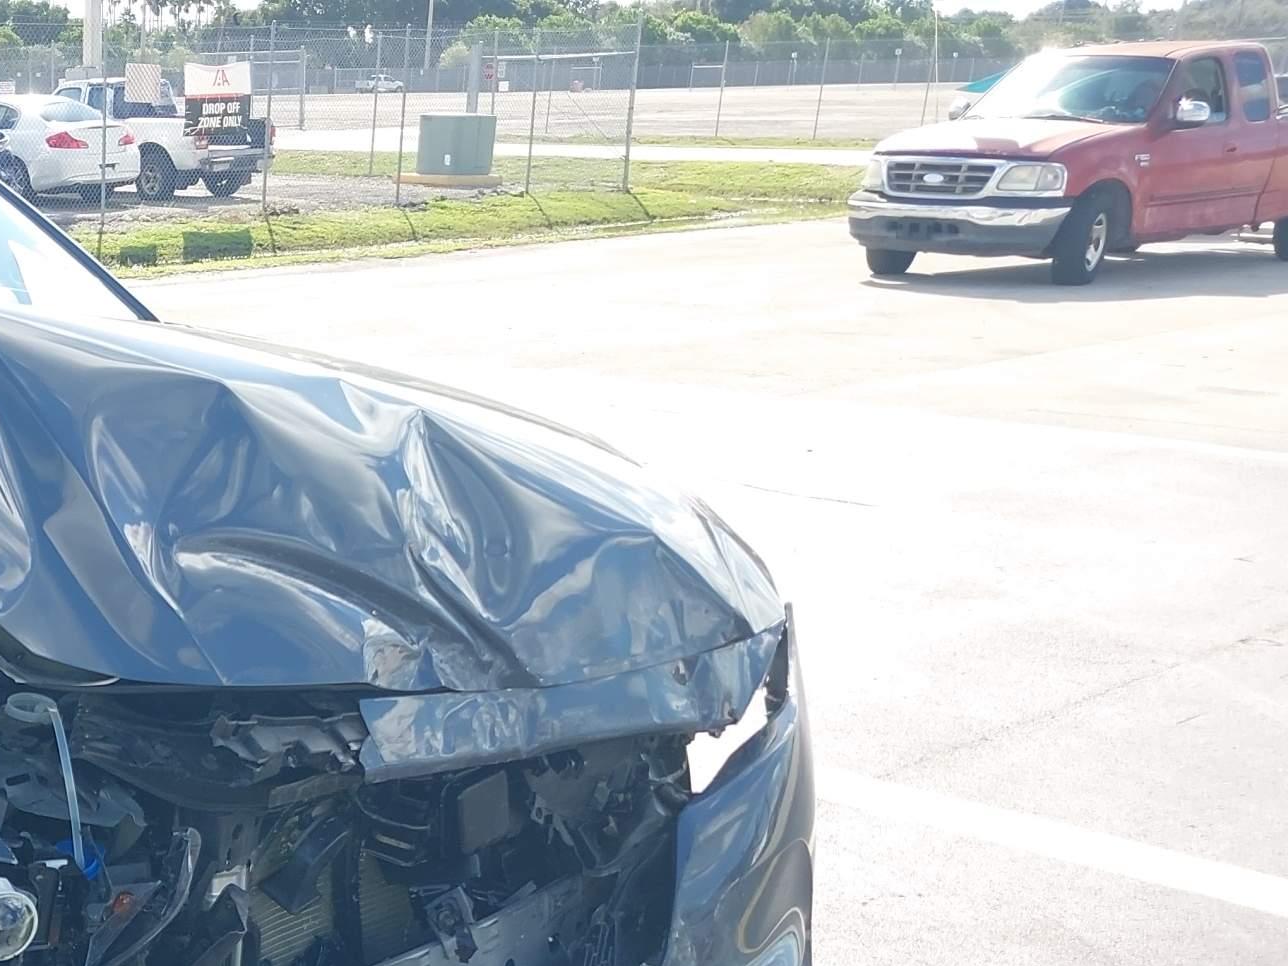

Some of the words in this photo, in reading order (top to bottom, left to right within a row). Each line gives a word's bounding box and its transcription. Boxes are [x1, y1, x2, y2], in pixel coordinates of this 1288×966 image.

[202, 102, 225, 115] DROP
[226, 101, 241, 114] OFF
[198, 116, 222, 128] ZONE
[222, 115, 242, 128] ONLY
